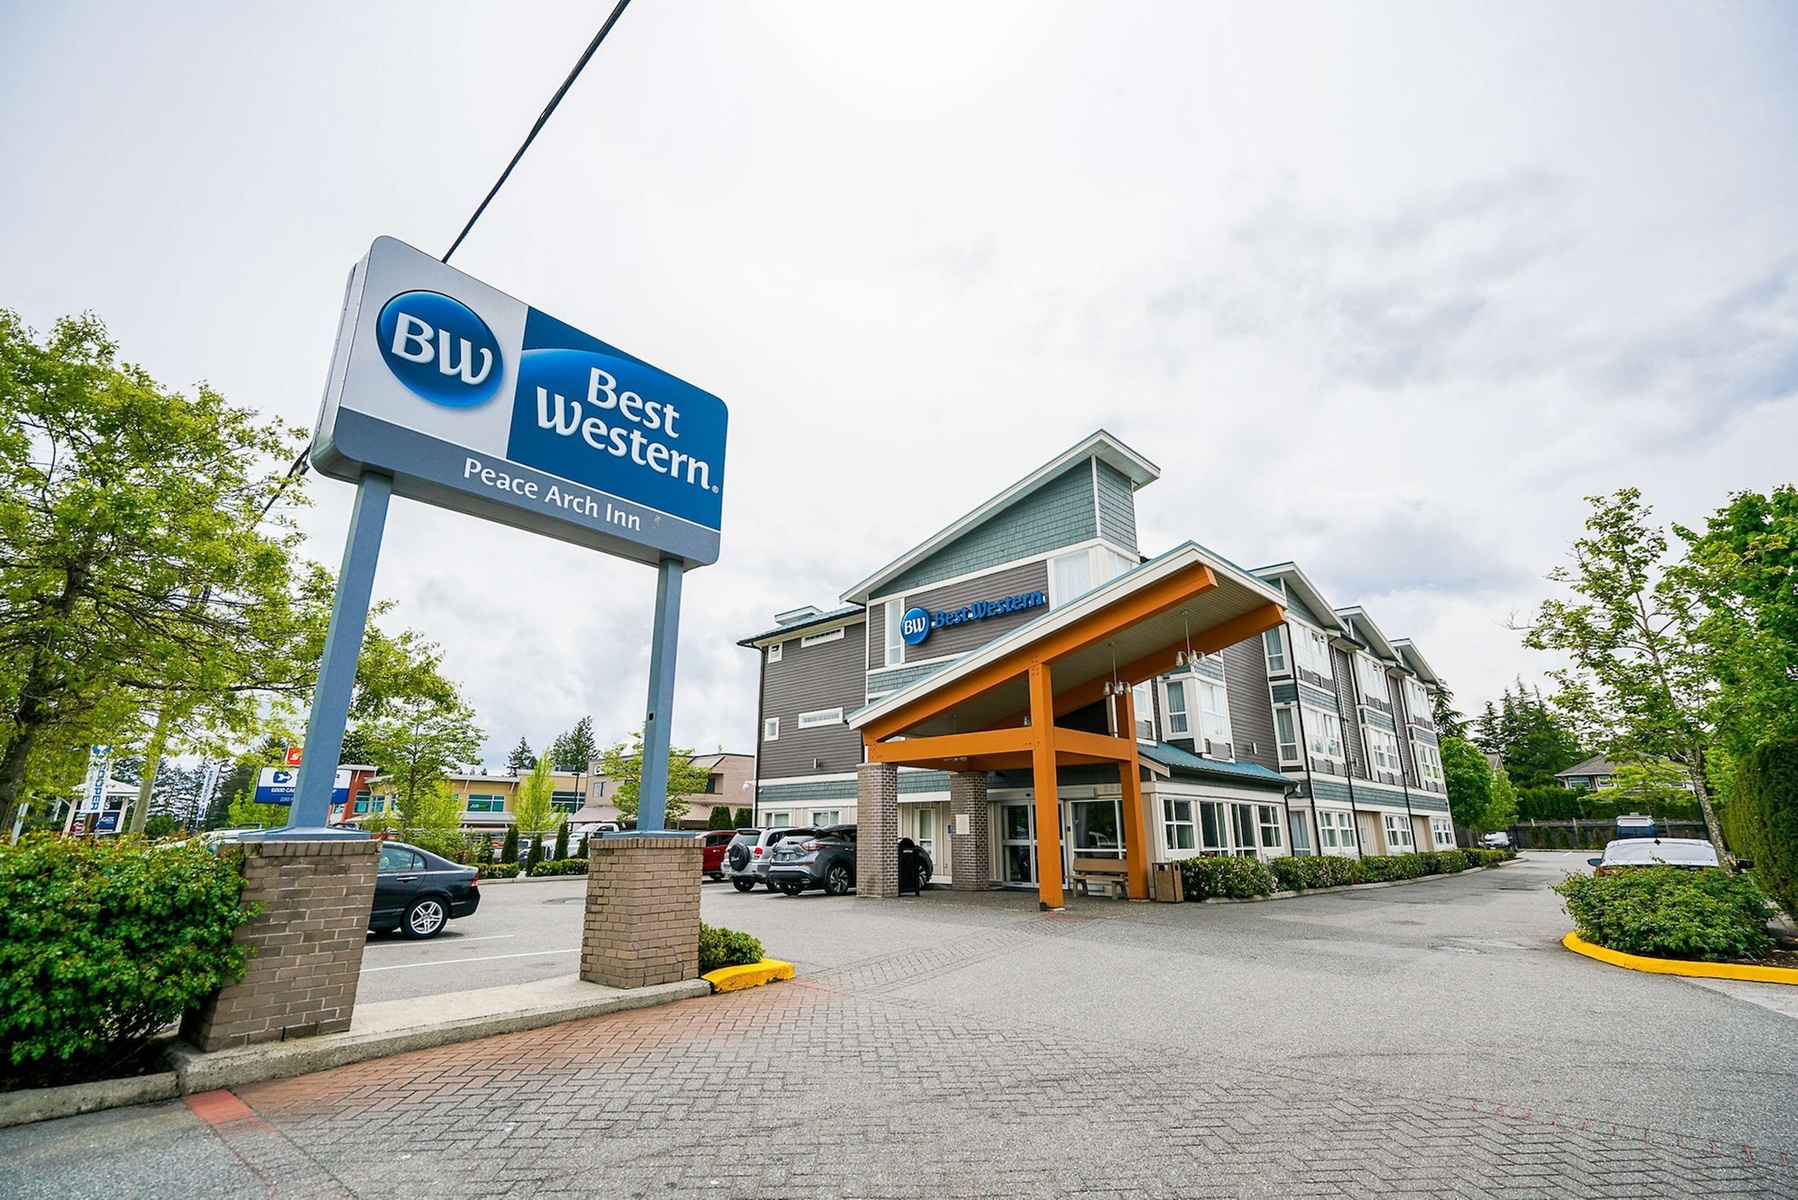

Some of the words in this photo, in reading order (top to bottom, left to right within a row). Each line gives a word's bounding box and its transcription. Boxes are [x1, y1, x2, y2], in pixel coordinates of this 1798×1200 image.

[391, 313, 493, 386] BW
[586, 367, 679, 439] Best
[464, 457, 538, 499] Peace
[544, 485, 599, 519] Arch
[605, 503, 641, 532] Inn
[904, 616, 926, 635] BW
[934, 607, 970, 628] Best
[970, 591, 1044, 619] Western
